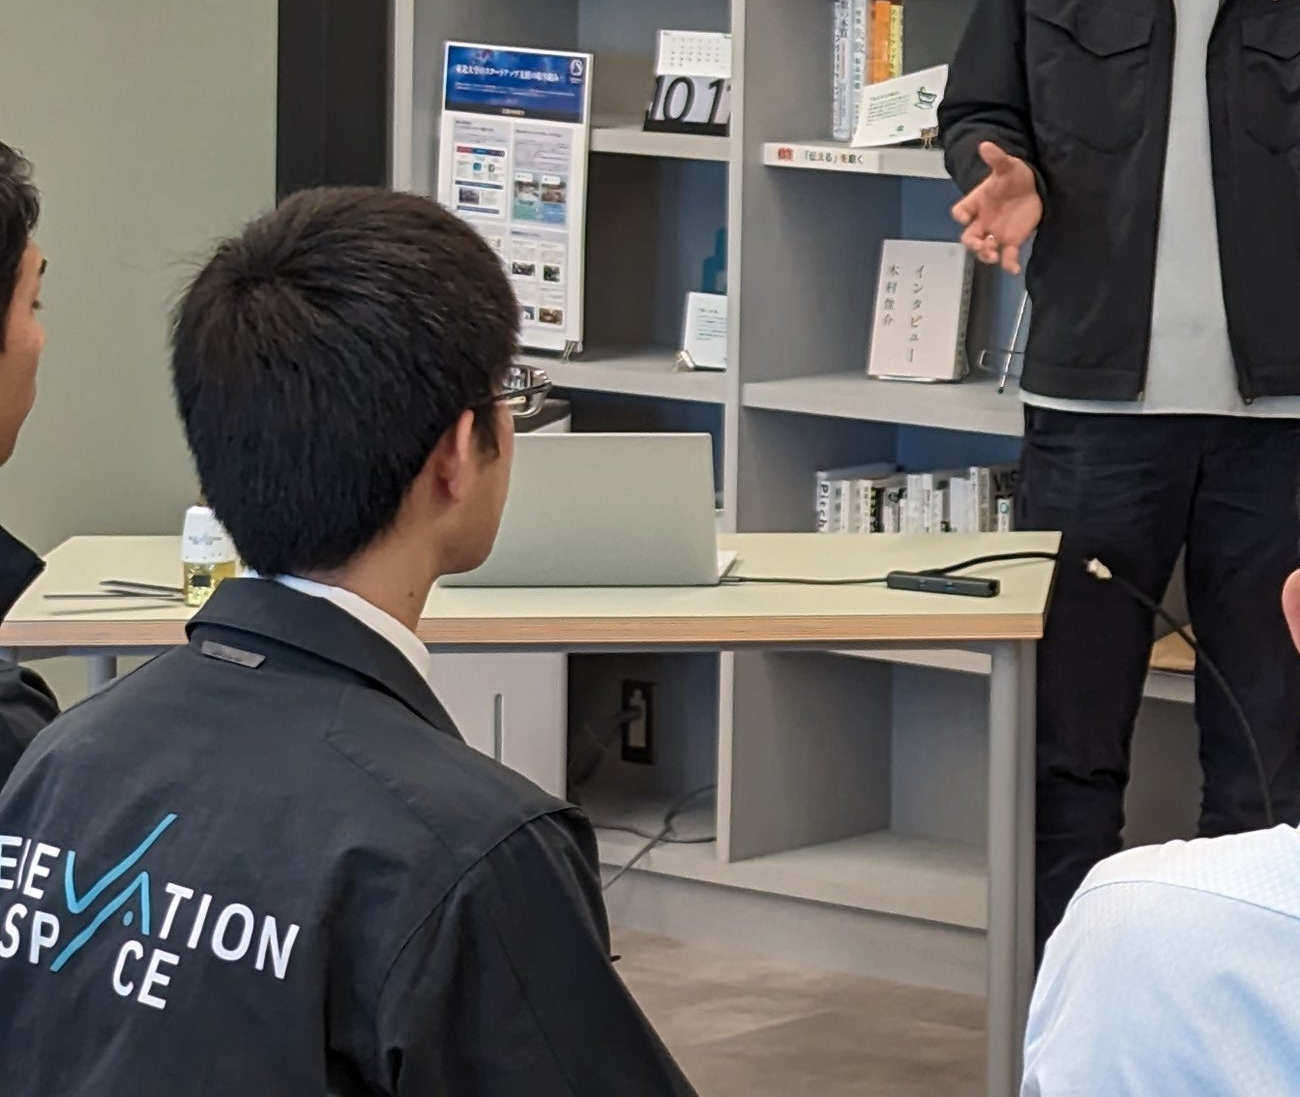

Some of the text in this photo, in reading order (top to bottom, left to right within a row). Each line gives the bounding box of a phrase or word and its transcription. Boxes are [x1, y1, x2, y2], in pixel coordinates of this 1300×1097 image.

[650, 74, 696, 121] 10
[908, 263, 926, 363] インタビュー
